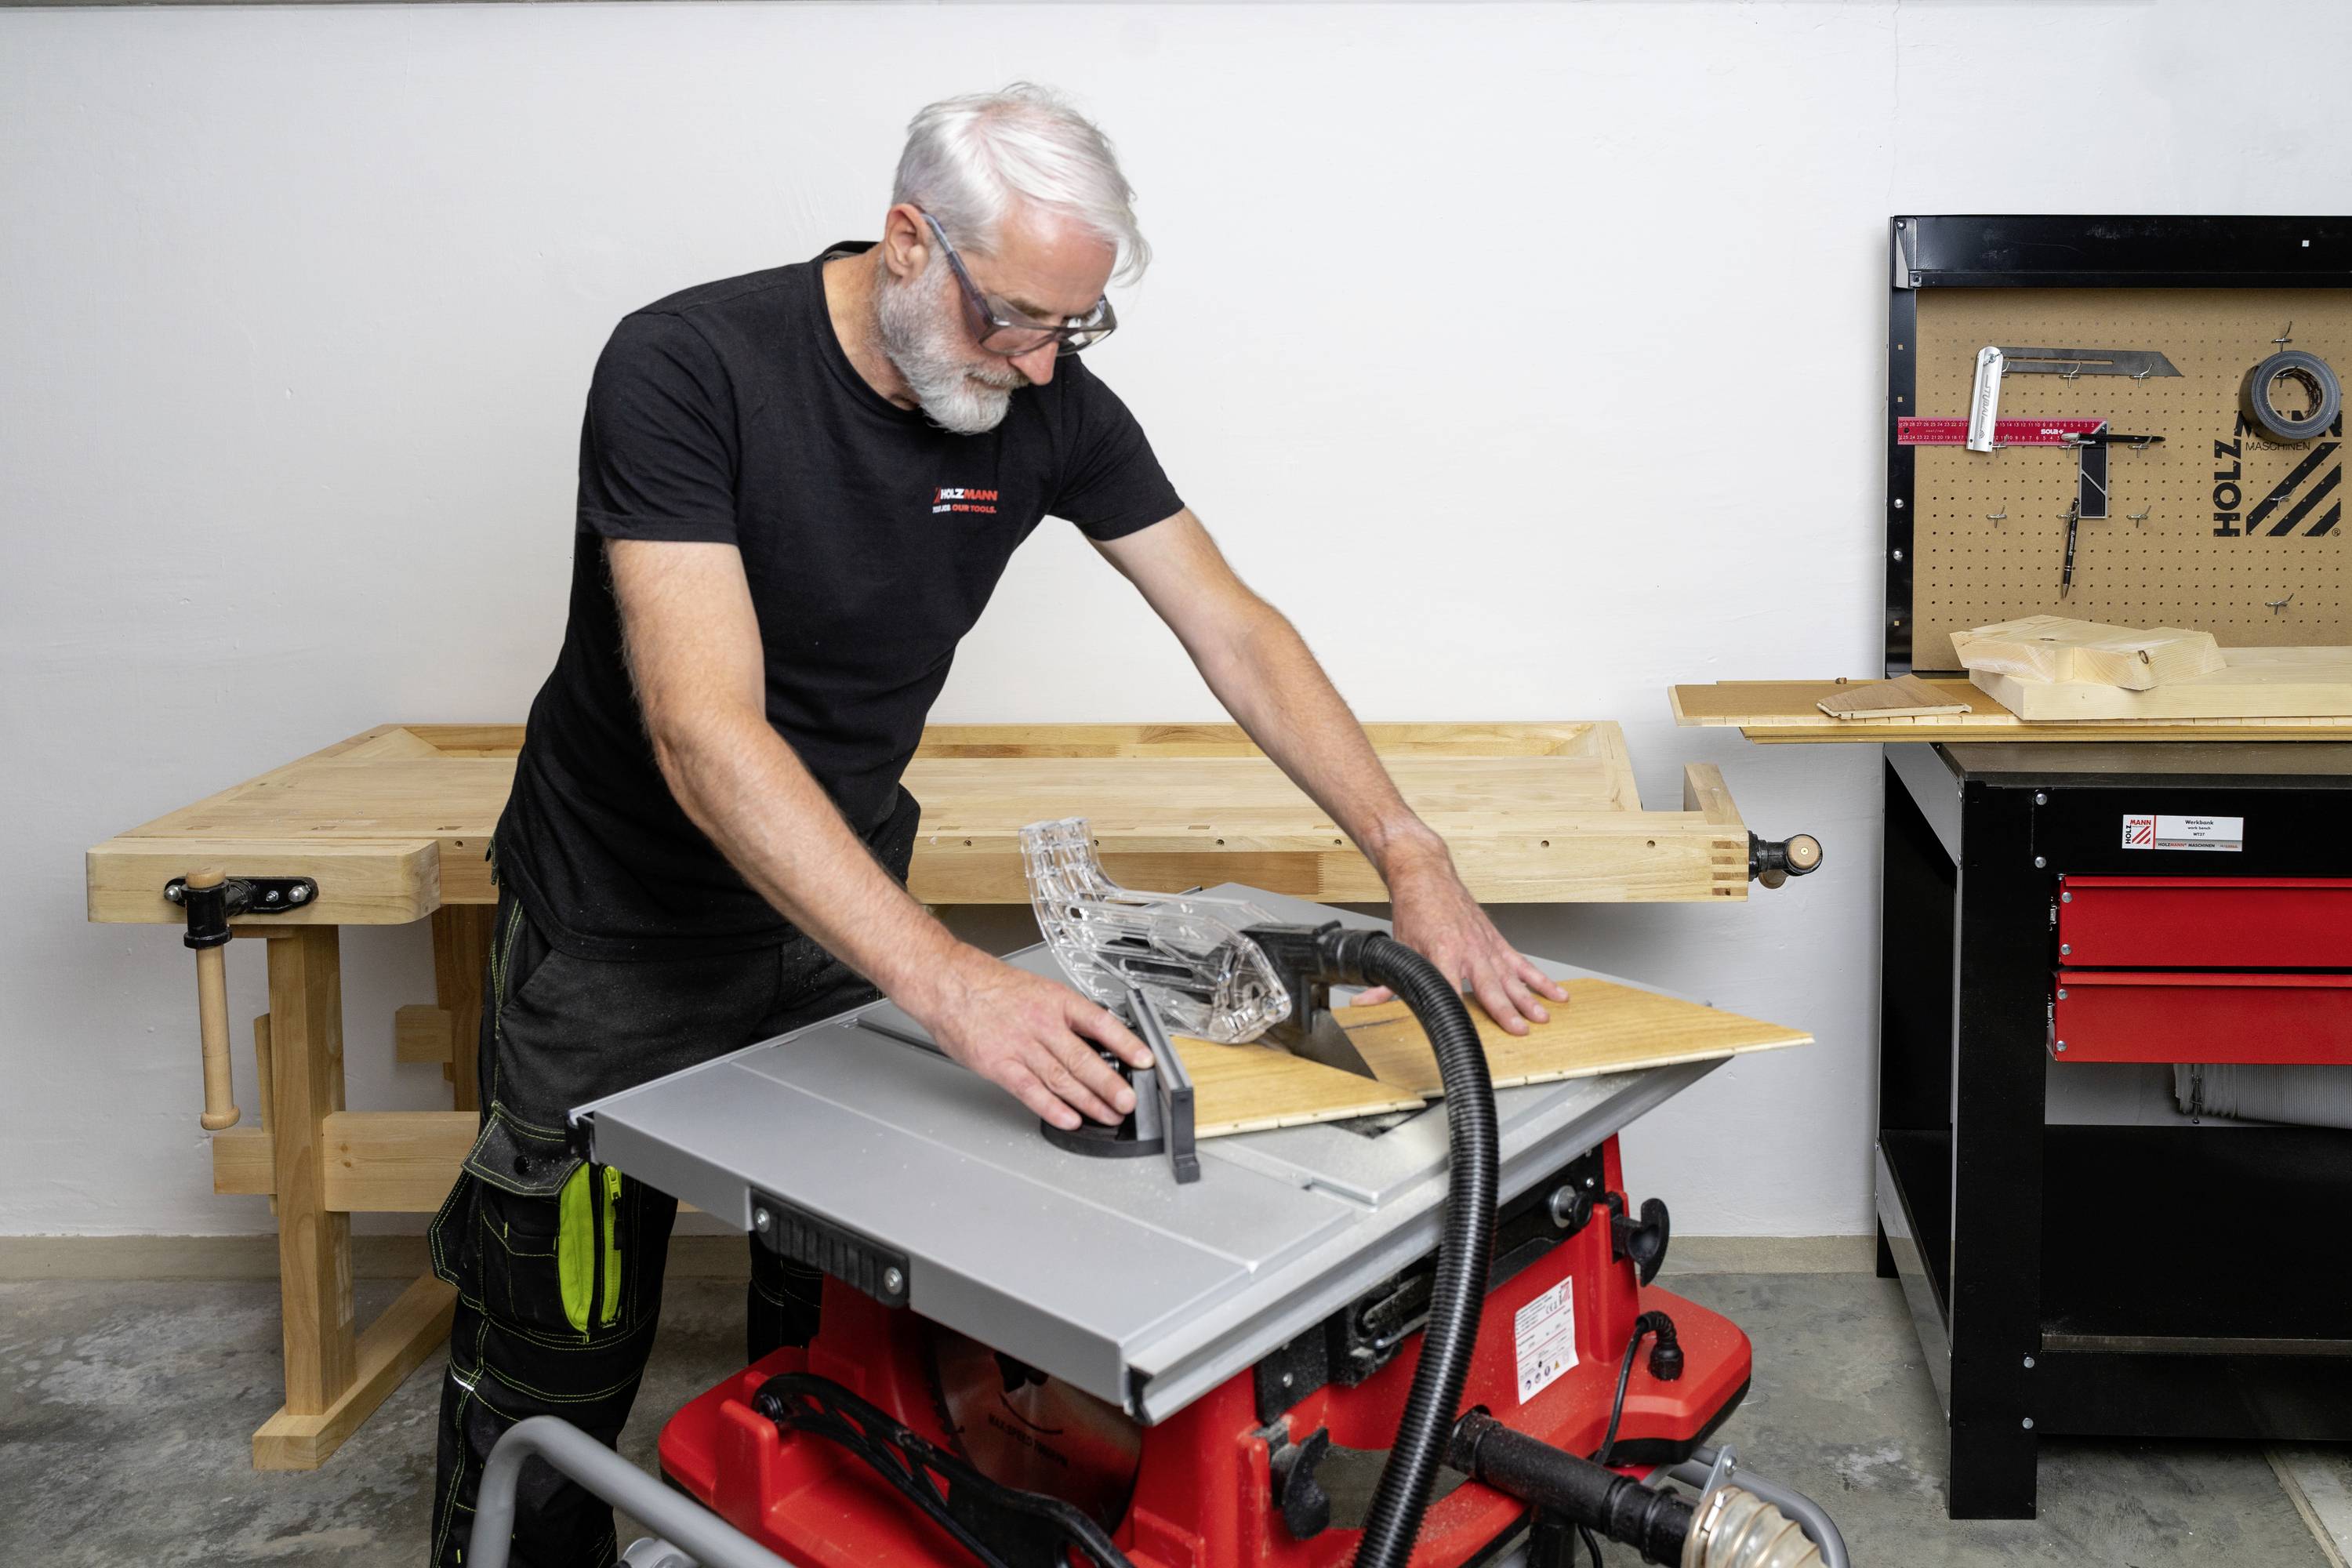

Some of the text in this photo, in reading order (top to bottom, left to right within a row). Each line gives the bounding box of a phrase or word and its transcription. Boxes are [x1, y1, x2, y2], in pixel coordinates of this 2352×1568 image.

[2245, 441, 2310, 451] MASCHINEN
[2212, 439, 2241, 537] HOLZ
[940, 488, 998, 502] HOLZMANN
[952, 503, 969, 512] OUR
[971, 504, 997, 514] TOOLS.
